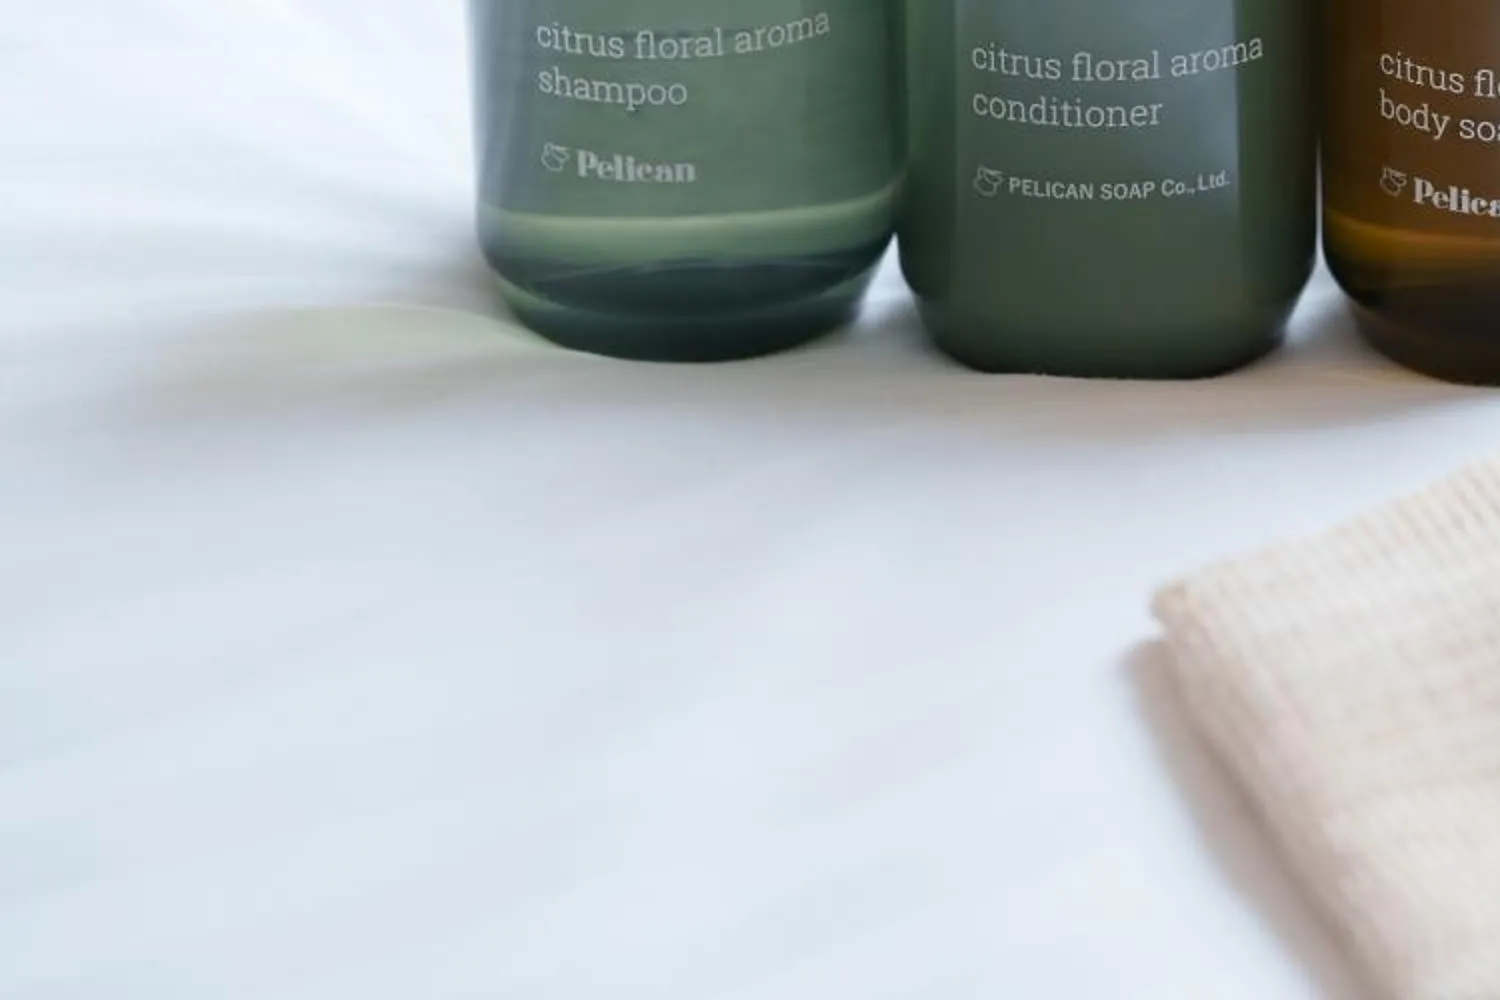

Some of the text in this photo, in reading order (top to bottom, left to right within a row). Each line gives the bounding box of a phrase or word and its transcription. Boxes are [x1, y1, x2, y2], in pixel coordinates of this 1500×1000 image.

[537, 12, 830, 59] citrus floral aroma
[971, 37, 1263, 82] citrus floral aroma
[1380, 51, 1464, 94] citrus
[538, 66, 687, 111] shampoo
[973, 93, 1163, 127] conditioner
[1379, 88, 1450, 140] body
[577, 149, 696, 182] Pelican
[1009, 177, 1094, 200] PELICAN
[1100, 183, 1155, 200] SOAP
